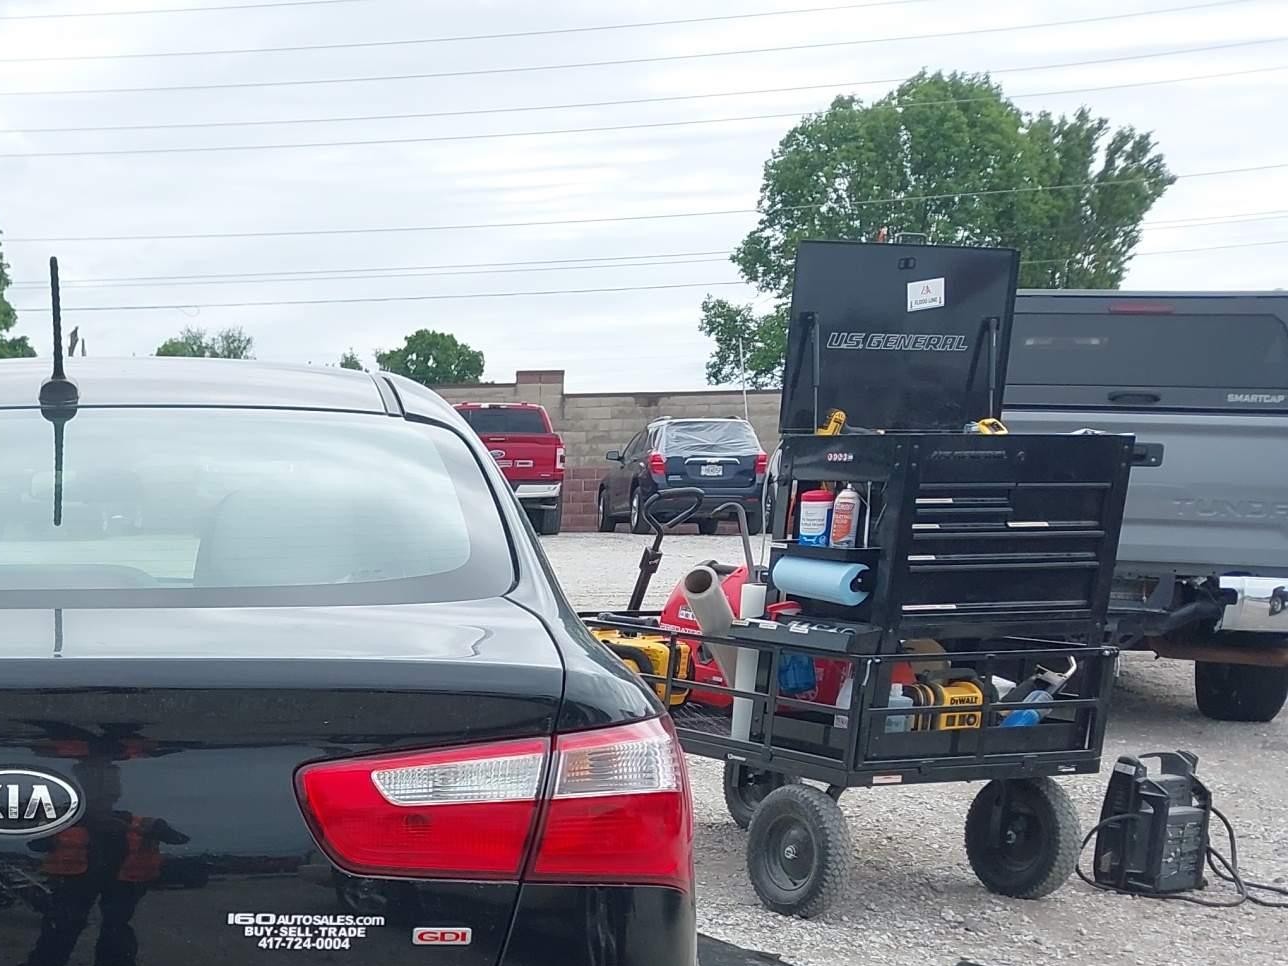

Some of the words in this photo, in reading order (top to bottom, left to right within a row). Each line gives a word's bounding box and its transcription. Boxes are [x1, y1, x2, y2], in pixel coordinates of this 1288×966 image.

[866, 333, 968, 351] GENERAL
[1227, 393, 1285, 403] SMARTCAP
[417, 931, 467, 943] GDI
[258, 937, 350, 950] 417-724-0004
